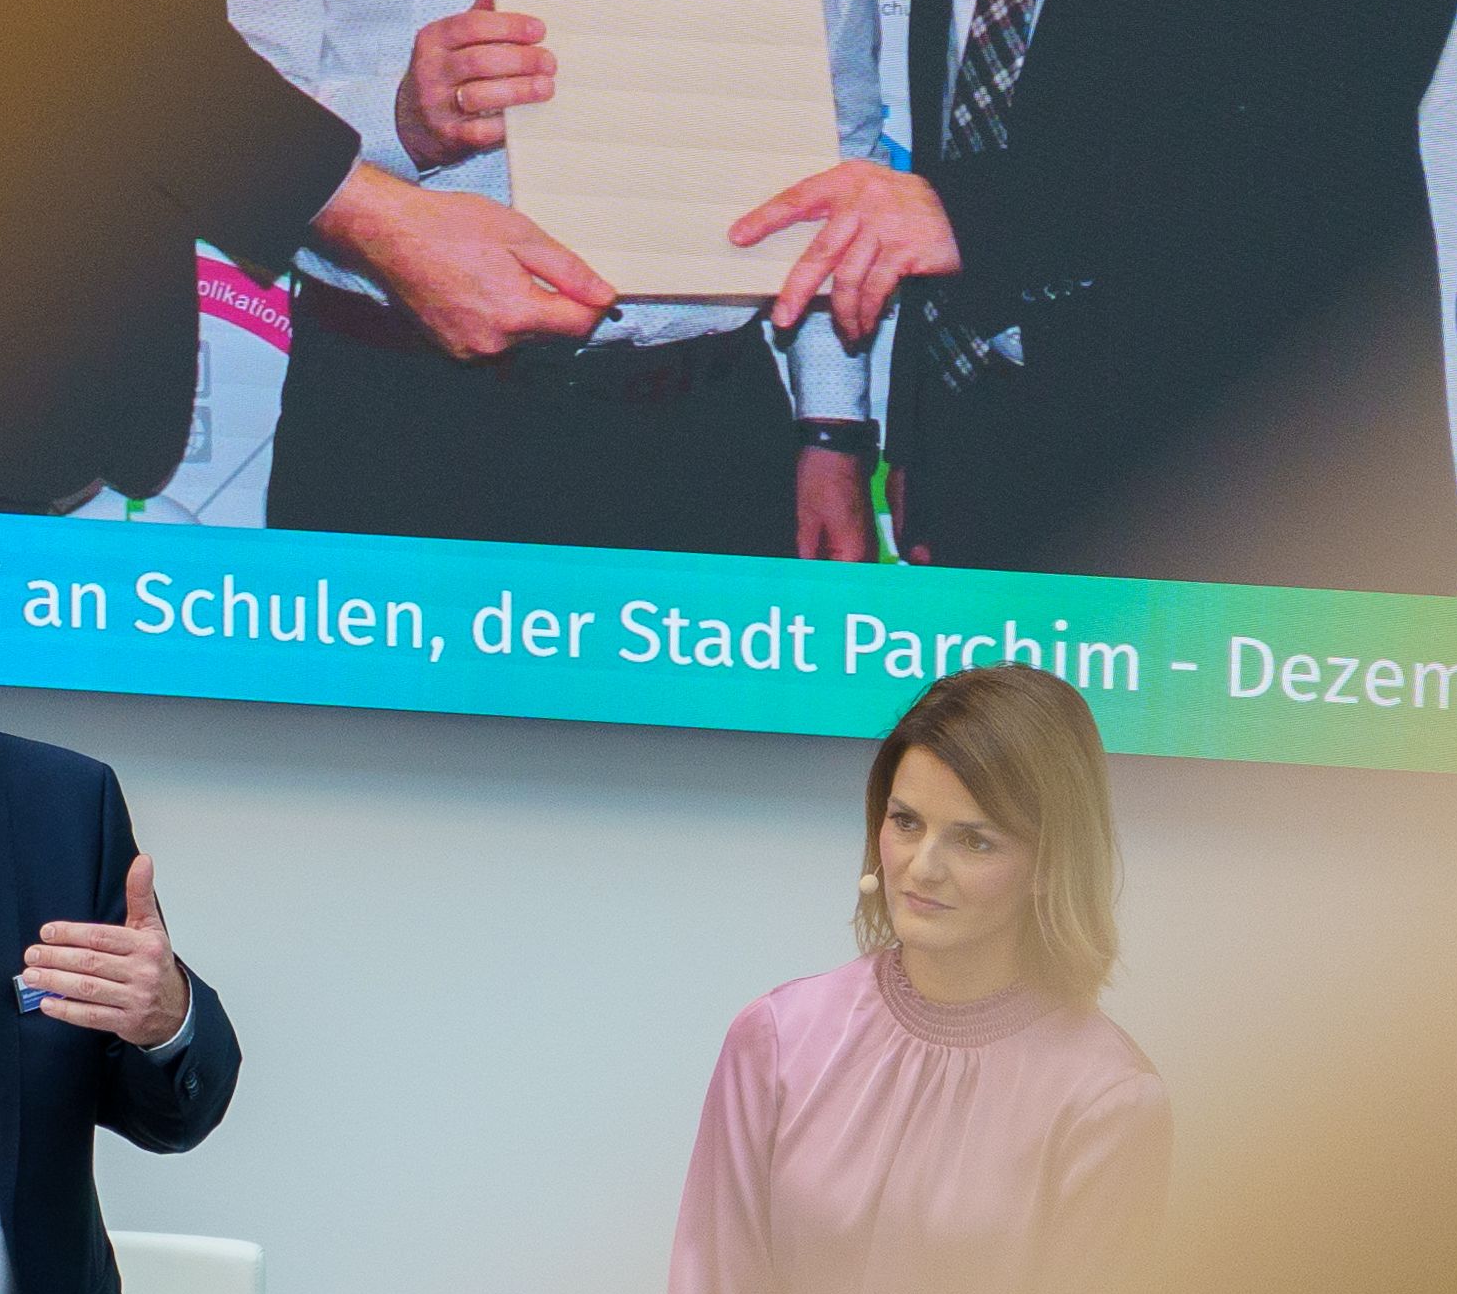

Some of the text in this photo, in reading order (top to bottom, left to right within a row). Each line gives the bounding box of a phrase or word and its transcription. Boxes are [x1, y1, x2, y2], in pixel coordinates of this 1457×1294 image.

[24, 577, 107, 629] an
[134, 571, 446, 663] Schulen,
[473, 590, 595, 658] der
[619, 599, 817, 674] Stadt
[844, 613, 1139, 691] Parchim
